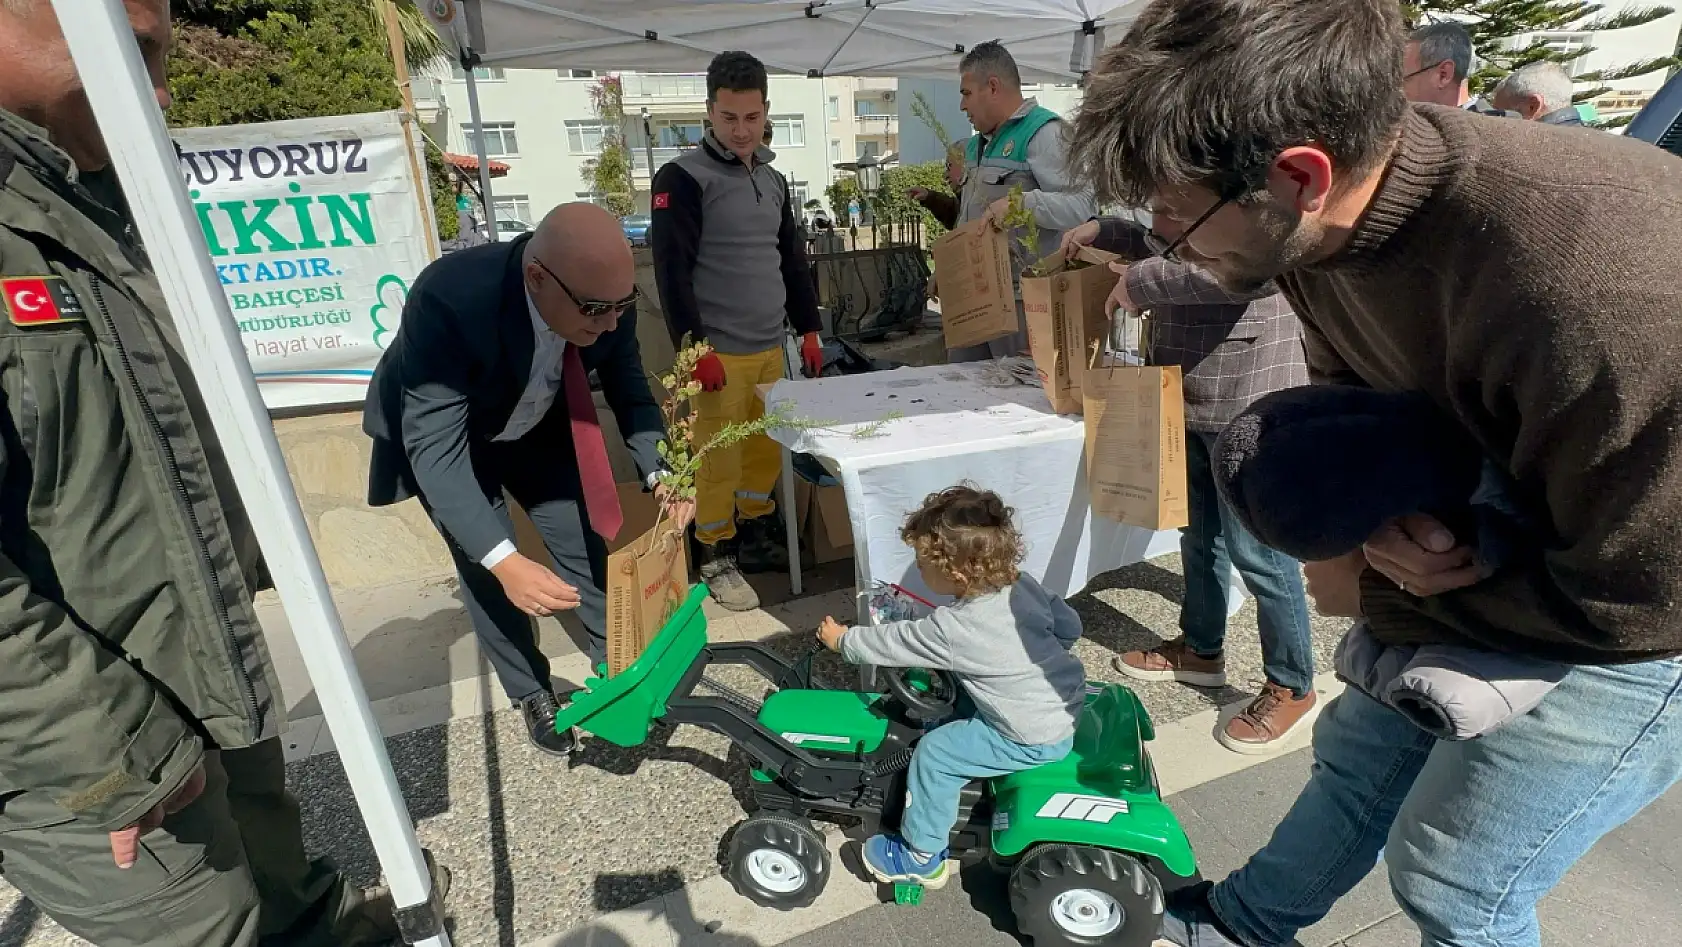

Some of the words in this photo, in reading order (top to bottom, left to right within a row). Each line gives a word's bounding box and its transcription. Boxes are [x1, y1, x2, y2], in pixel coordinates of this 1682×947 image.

[180, 139, 368, 185] UYORUZ
[232, 282, 345, 309] BAHÇESİ
[254, 335, 309, 358] hayat
[312, 334, 359, 350] var...
